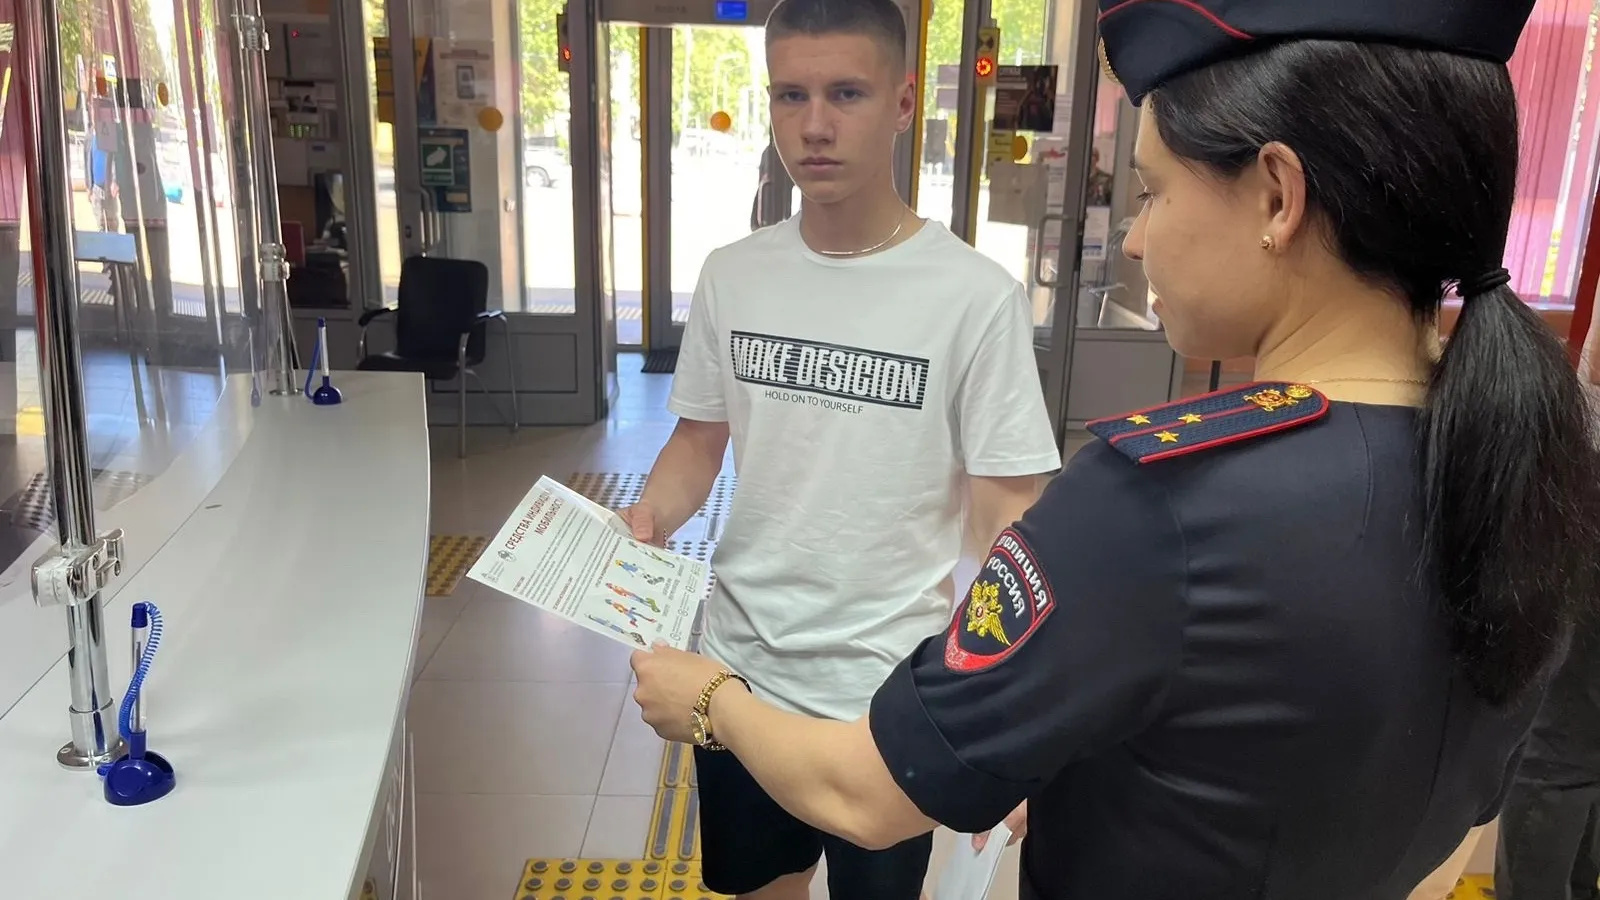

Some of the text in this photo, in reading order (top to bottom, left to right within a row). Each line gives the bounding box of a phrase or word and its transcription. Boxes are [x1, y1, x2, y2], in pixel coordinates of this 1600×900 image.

[733, 337, 922, 403] MAKE DESICION
[765, 390, 864, 414] HOLD ON TO YOURSELF
[505, 519, 532, 550] СРЕДСТВА
[996, 535, 1048, 611] ПОЛИЦИЯ
